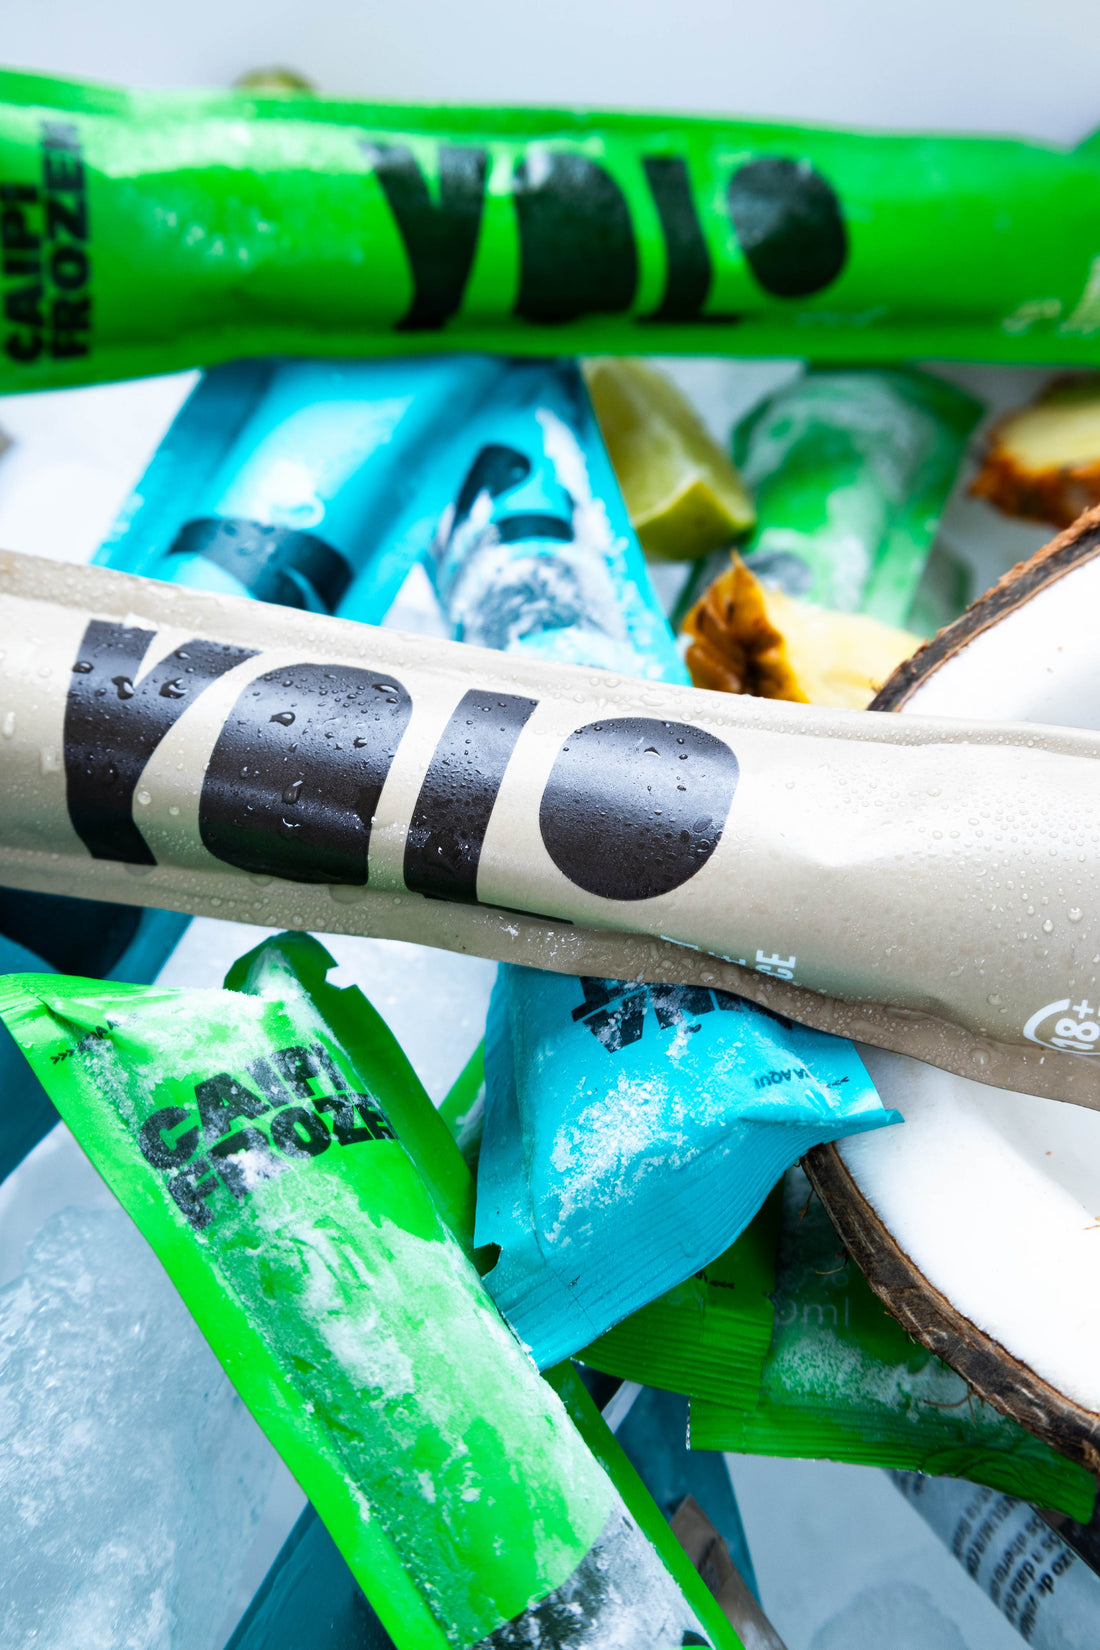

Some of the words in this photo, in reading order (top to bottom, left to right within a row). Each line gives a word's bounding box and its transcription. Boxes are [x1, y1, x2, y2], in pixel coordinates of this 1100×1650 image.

[0, 184, 44, 363] CAIPI
[1050, 1000, 1100, 1050] 18+
[753, 1069, 793, 1090] AQUI
[138, 1043, 351, 1170] CAIPI
[1010, 1560, 1036, 1597] data
[1035, 1573, 1055, 1599] de
